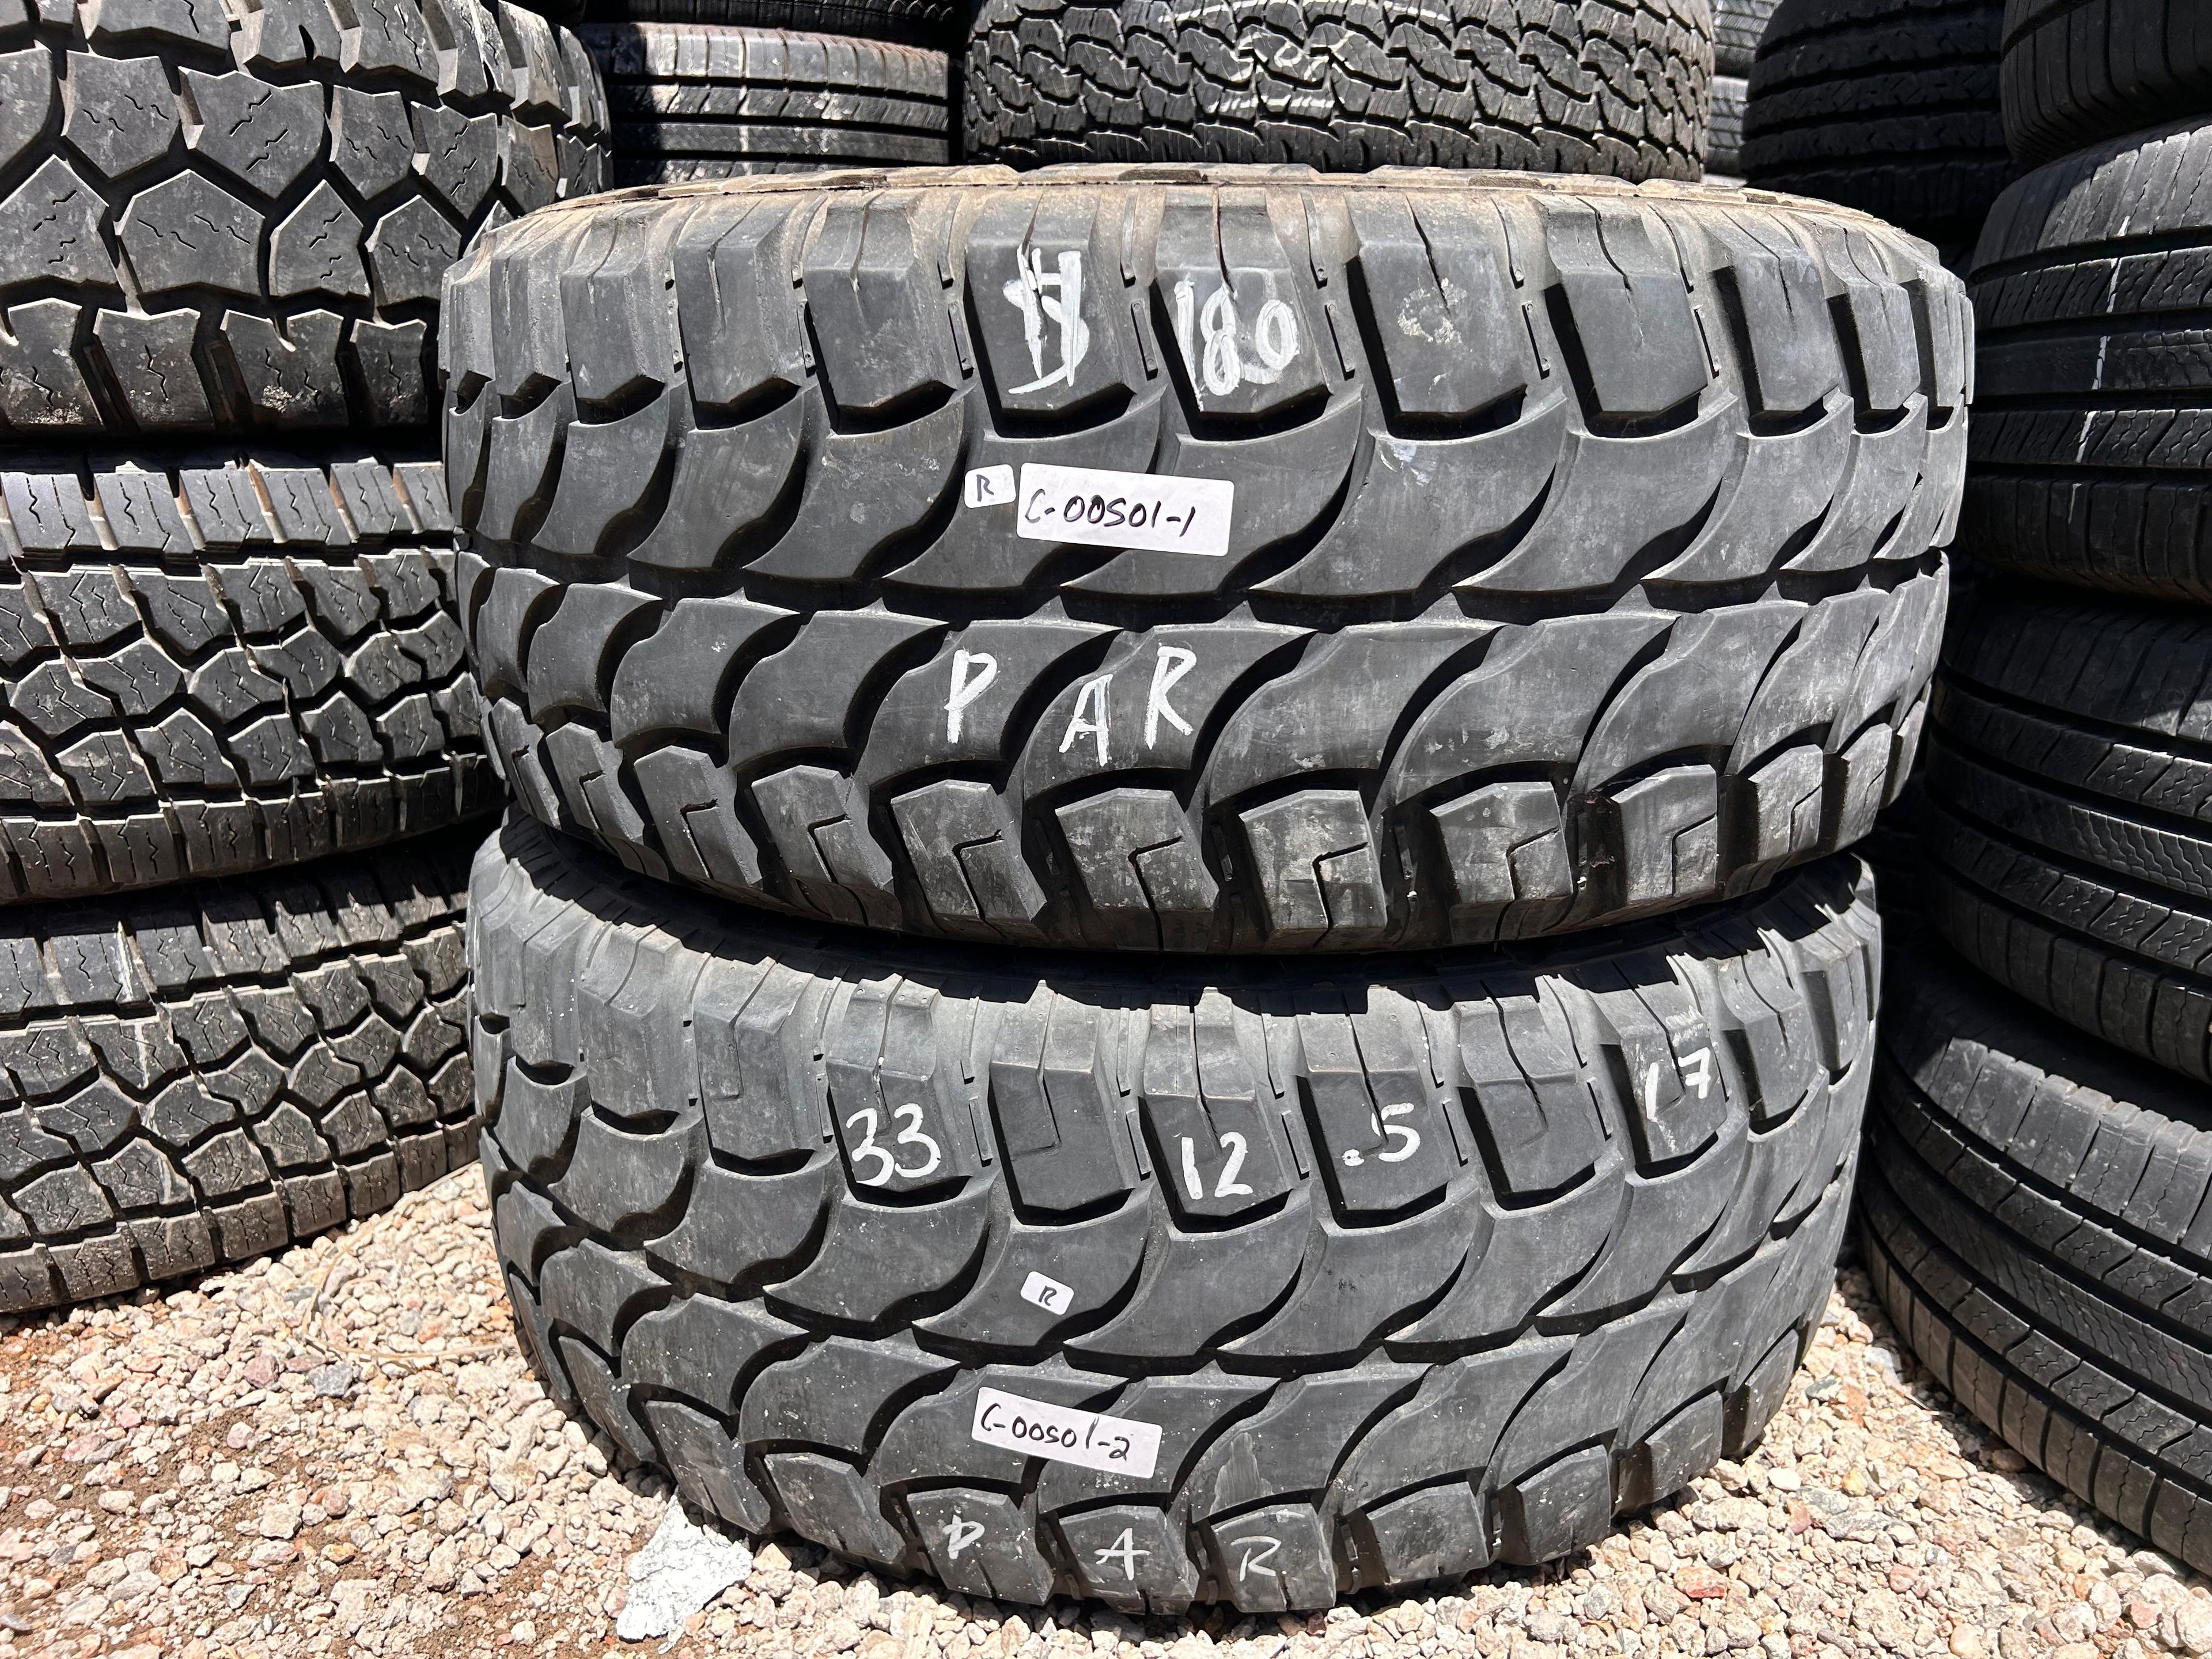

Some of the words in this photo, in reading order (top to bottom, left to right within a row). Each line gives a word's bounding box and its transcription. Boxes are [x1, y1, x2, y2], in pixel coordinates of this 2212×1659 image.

[976, 474, 994, 501] R
[846, 1103, 941, 1187] 33
[1181, 1131, 1253, 1200] 12
[1645, 1047, 1710, 1121] 17
[1038, 1286, 1053, 1306] R
